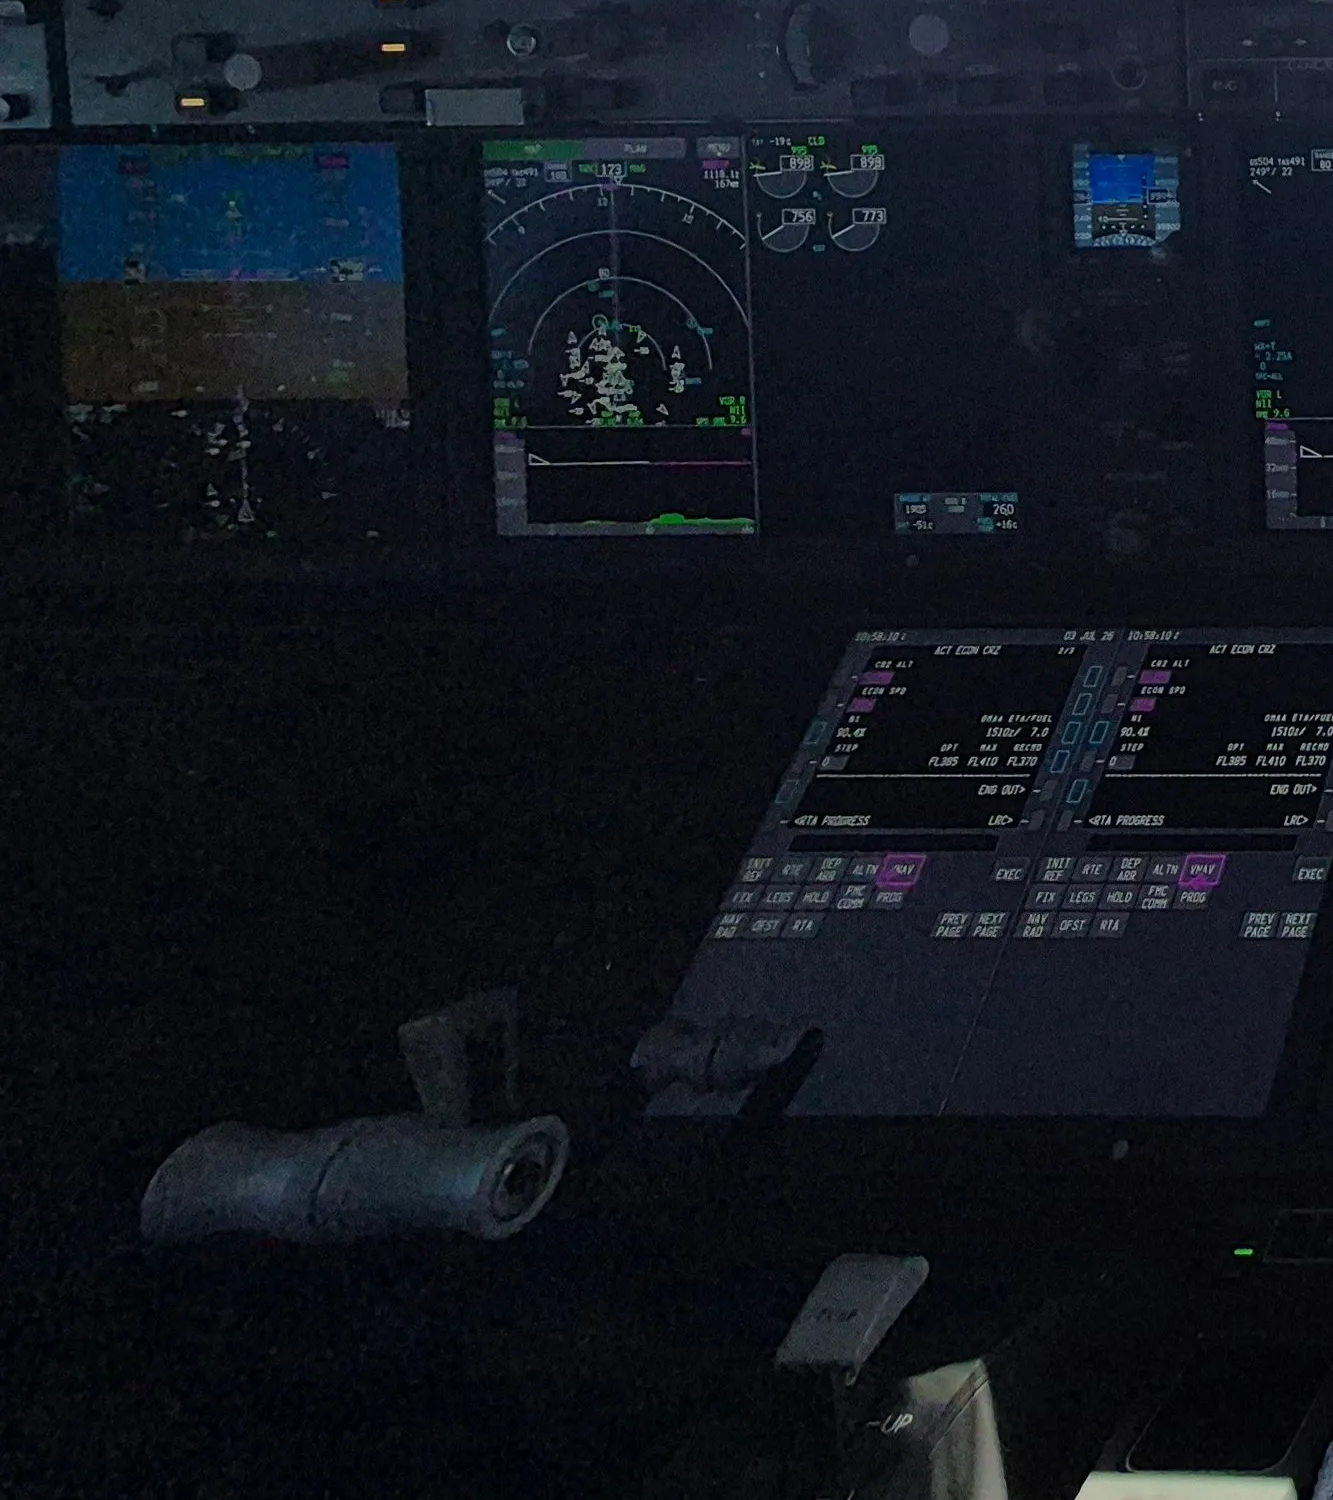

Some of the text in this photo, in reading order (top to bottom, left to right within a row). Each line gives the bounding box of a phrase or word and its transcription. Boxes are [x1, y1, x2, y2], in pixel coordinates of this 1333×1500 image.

[993, 503, 1015, 516] 760
[933, 645, 952, 656] ACT
[1208, 644, 1227, 655] ACT
[1030, 726, 1050, 738] 7.0
[1120, 742, 1145, 753] STEP
[966, 755, 1039, 768] FL410 FL370
[1254, 754, 1287, 767] FL410
[1294, 754, 1327, 767] FL370
[1115, 814, 1166, 827] PROGRESS
[1046, 857, 1073, 869] INIT
[1120, 857, 1141, 869] DEP
[1189, 863, 1216, 875] VNAV
[995, 868, 1021, 880] EXEC
[1042, 870, 1064, 881] REF
[1081, 863, 1102, 876] RTE
[1116, 870, 1138, 881] ARR
[1151, 864, 1179, 876] ALTN
[1297, 868, 1324, 880] EXEC
[1147, 884, 1169, 896] FMC
[802, 891, 830, 903] HOLD
[1034, 891, 1134, 903] FIX LEGS HOLD
[1179, 890, 1207, 903] PROG
[1140, 897, 1169, 909] COMM
[940, 913, 968, 925] PREV
[977, 912, 1006, 925] NEXT
[1027, 913, 1049, 925] NAV
[1246, 914, 1274, 925] PREV
[1284, 912, 1312, 925] NEXT
[1058, 918, 1120, 932] OFST RTA
[935, 926, 963, 938] PAGE
[972, 926, 1001, 938] PAGE
[1022, 926, 1044, 938] RAD
[1243, 926, 1272, 938] PAGE
[1280, 926, 1309, 938] PAGE
